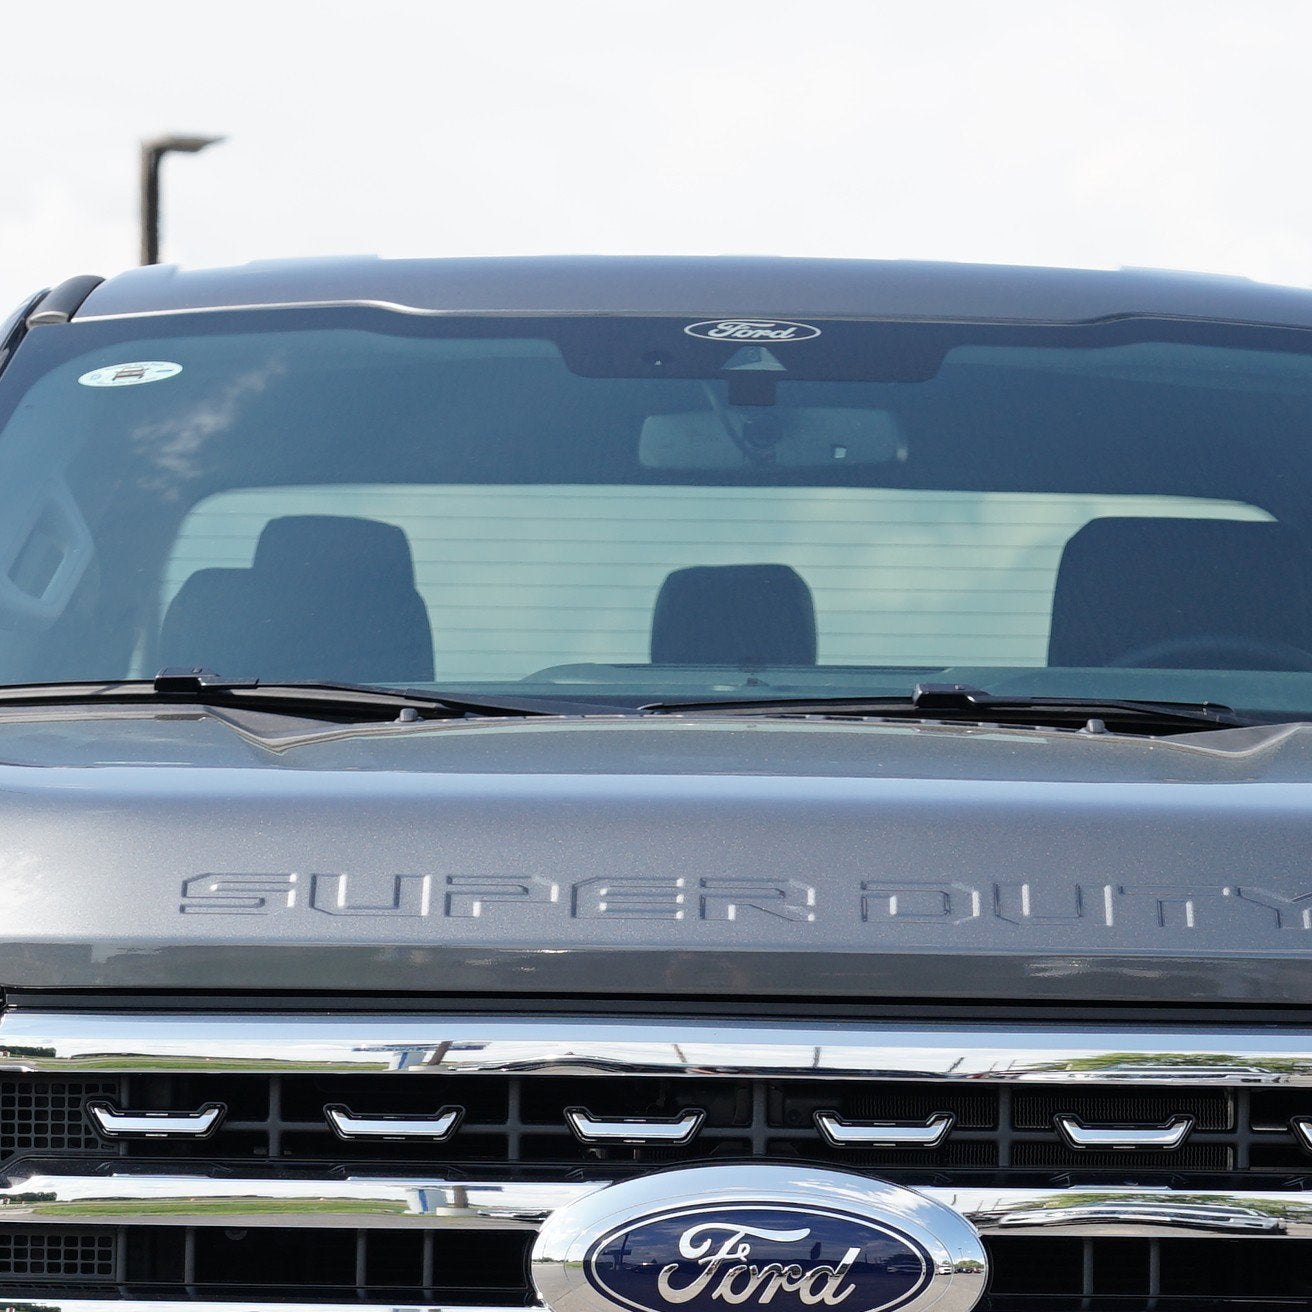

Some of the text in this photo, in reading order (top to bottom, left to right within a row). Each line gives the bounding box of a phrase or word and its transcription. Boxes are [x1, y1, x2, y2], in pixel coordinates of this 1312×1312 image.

[708, 321, 798, 338] Ford
[180, 872, 815, 922] SUPER
[657, 1222, 861, 1306] Ford
